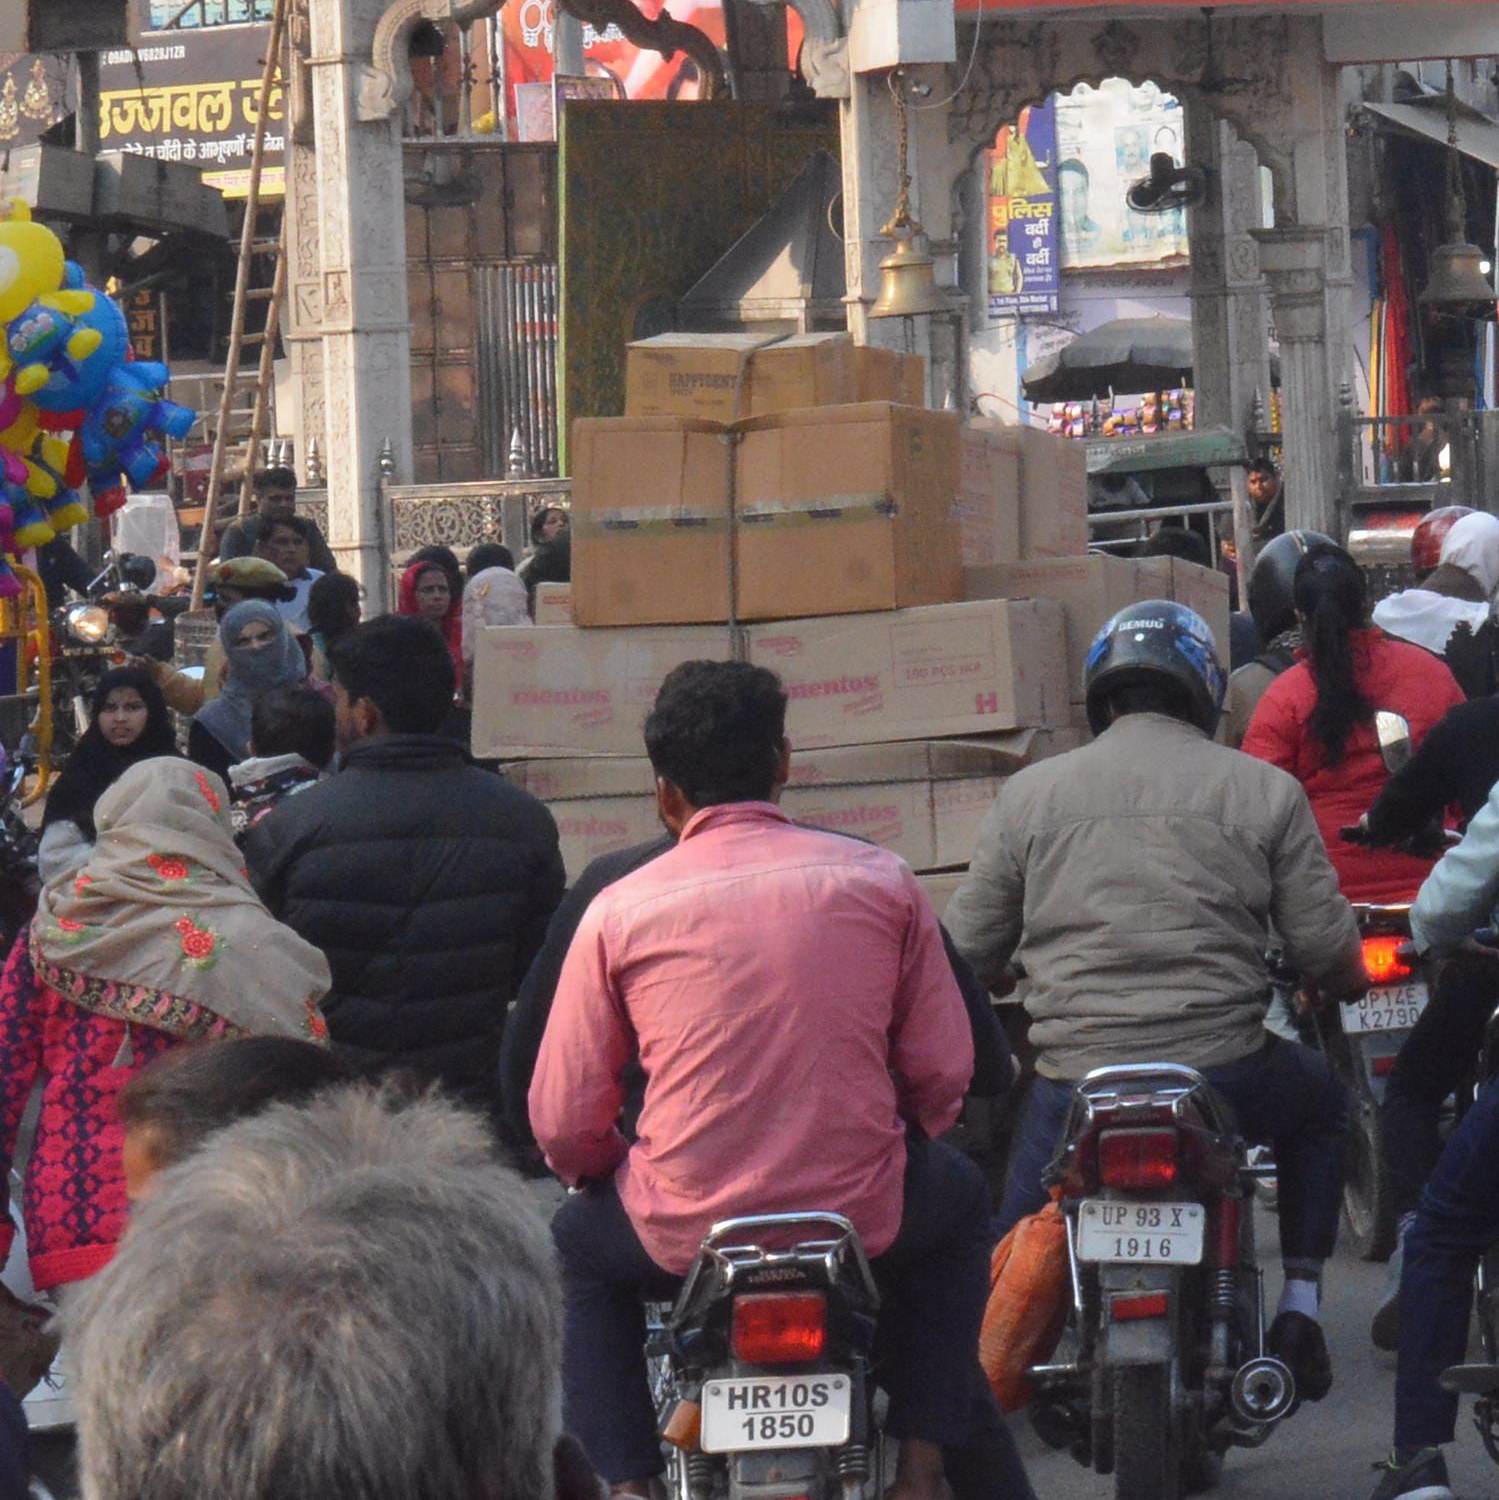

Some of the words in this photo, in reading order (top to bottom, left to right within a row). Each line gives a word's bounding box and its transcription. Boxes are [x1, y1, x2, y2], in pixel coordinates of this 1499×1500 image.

[992, 199, 1054, 228] पुलिस
[1024, 219, 1051, 236] वर्दी
[1026, 249, 1051, 266] वर्दी
[512, 688, 609, 706] mentos
[784, 674, 880, 699] mentos
[976, 692, 998, 715] H
[1359, 1007, 1419, 1030] K2790
[1102, 1205, 1128, 1226] UP
[1136, 1207, 1161, 1227] 93
[1171, 1208, 1184, 1228] X
[1114, 1238, 1172, 1258] 1916
[727, 1382, 830, 1411] HR10S
[741, 1413, 815, 1441] 1850
